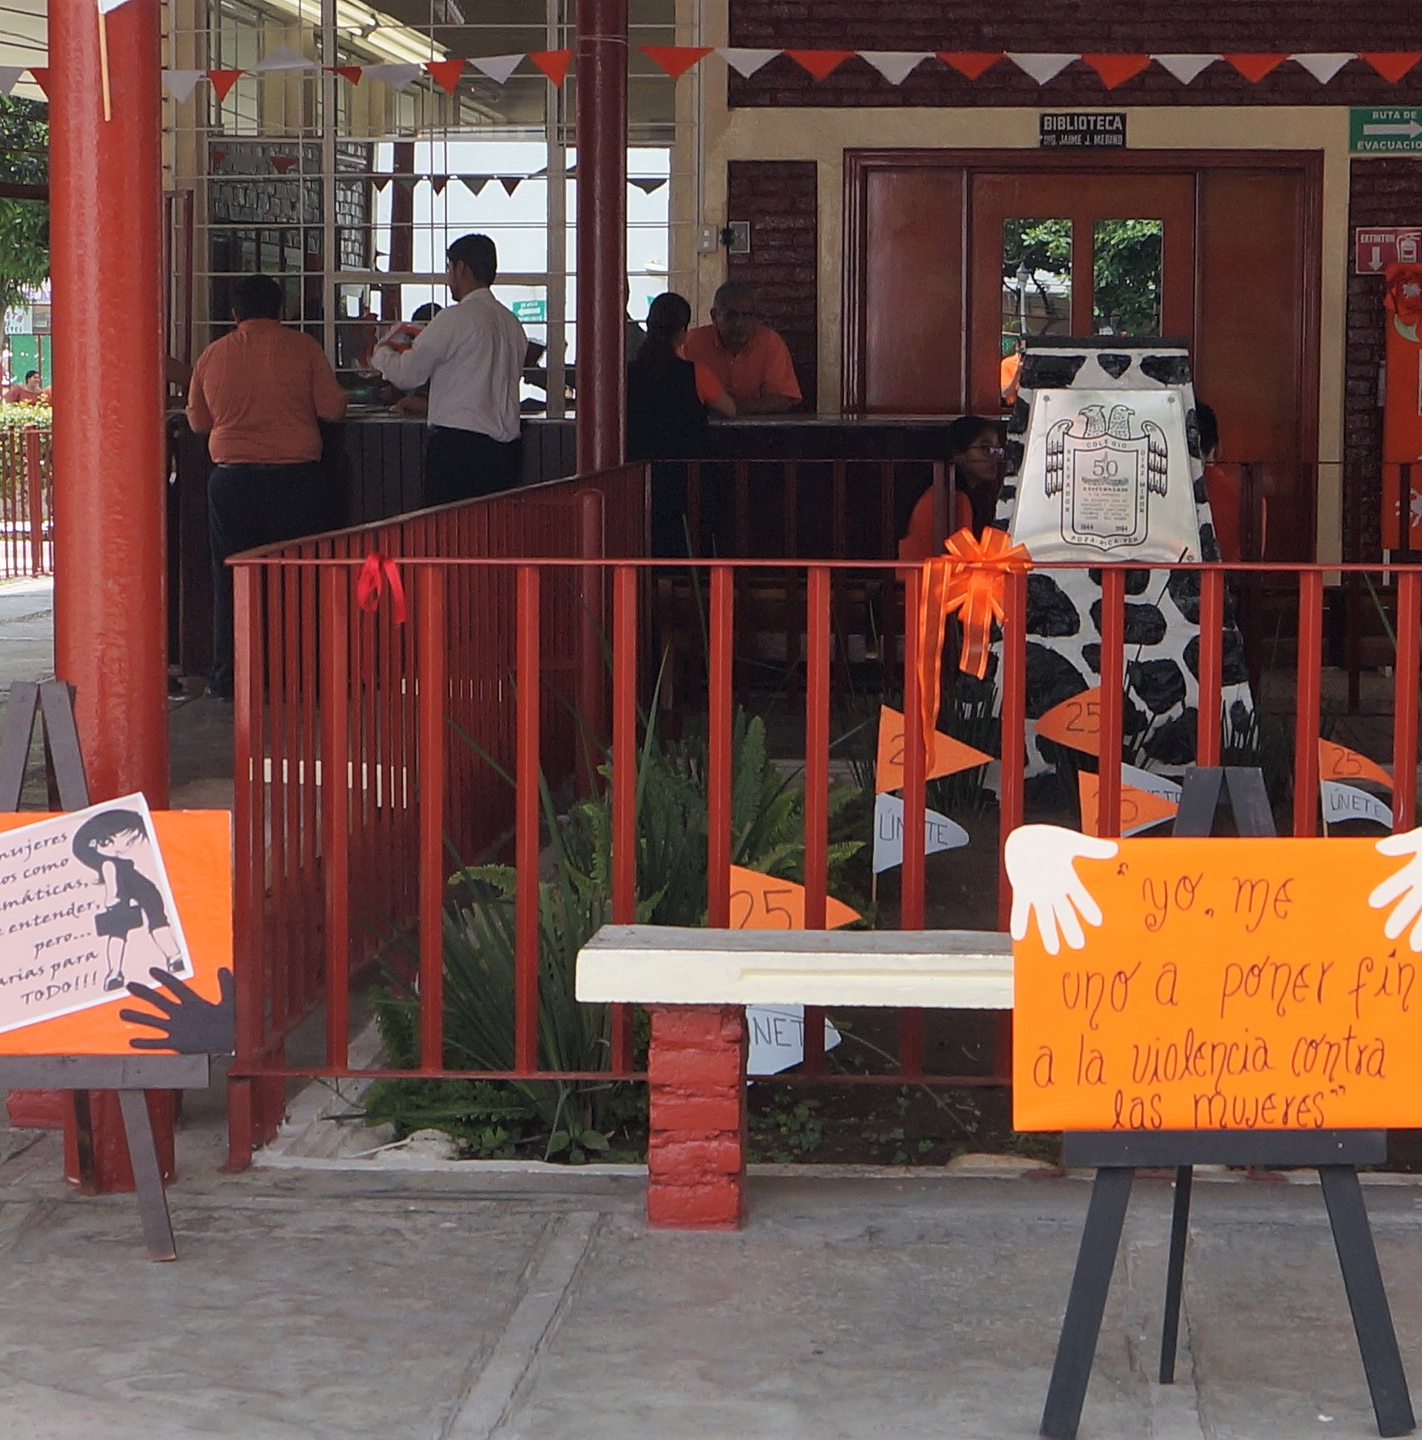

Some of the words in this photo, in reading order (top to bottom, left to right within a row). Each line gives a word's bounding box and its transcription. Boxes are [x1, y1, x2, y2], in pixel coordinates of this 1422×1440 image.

[1043, 115, 1123, 131] BIBLIOTECA
[1372, 111, 1400, 119] RUTA
[1403, 111, 1417, 119] DE
[1092, 459, 1118, 477] 50
[1332, 747, 1362, 776] 25
[1330, 787, 1381, 818] ÚNETE
[879, 808, 949, 846] ÚNTE
[23, 858, 69, 879] como
[9, 901, 100, 934] entender,
[1232, 876, 1295, 933] me
[34, 930, 92, 959] pero...
[50, 951, 99, 981] para
[1062, 961, 1142, 1030] uno
[1155, 962, 1178, 1007] a
[1220, 955, 1335, 1019] poner
[1033, 1045, 1055, 1089] a
[1077, 1034, 1107, 1086] la
[1132, 1028, 1274, 1091] violencia
[1291, 1025, 1386, 1082] contra
[1111, 1093, 1163, 1130] las
